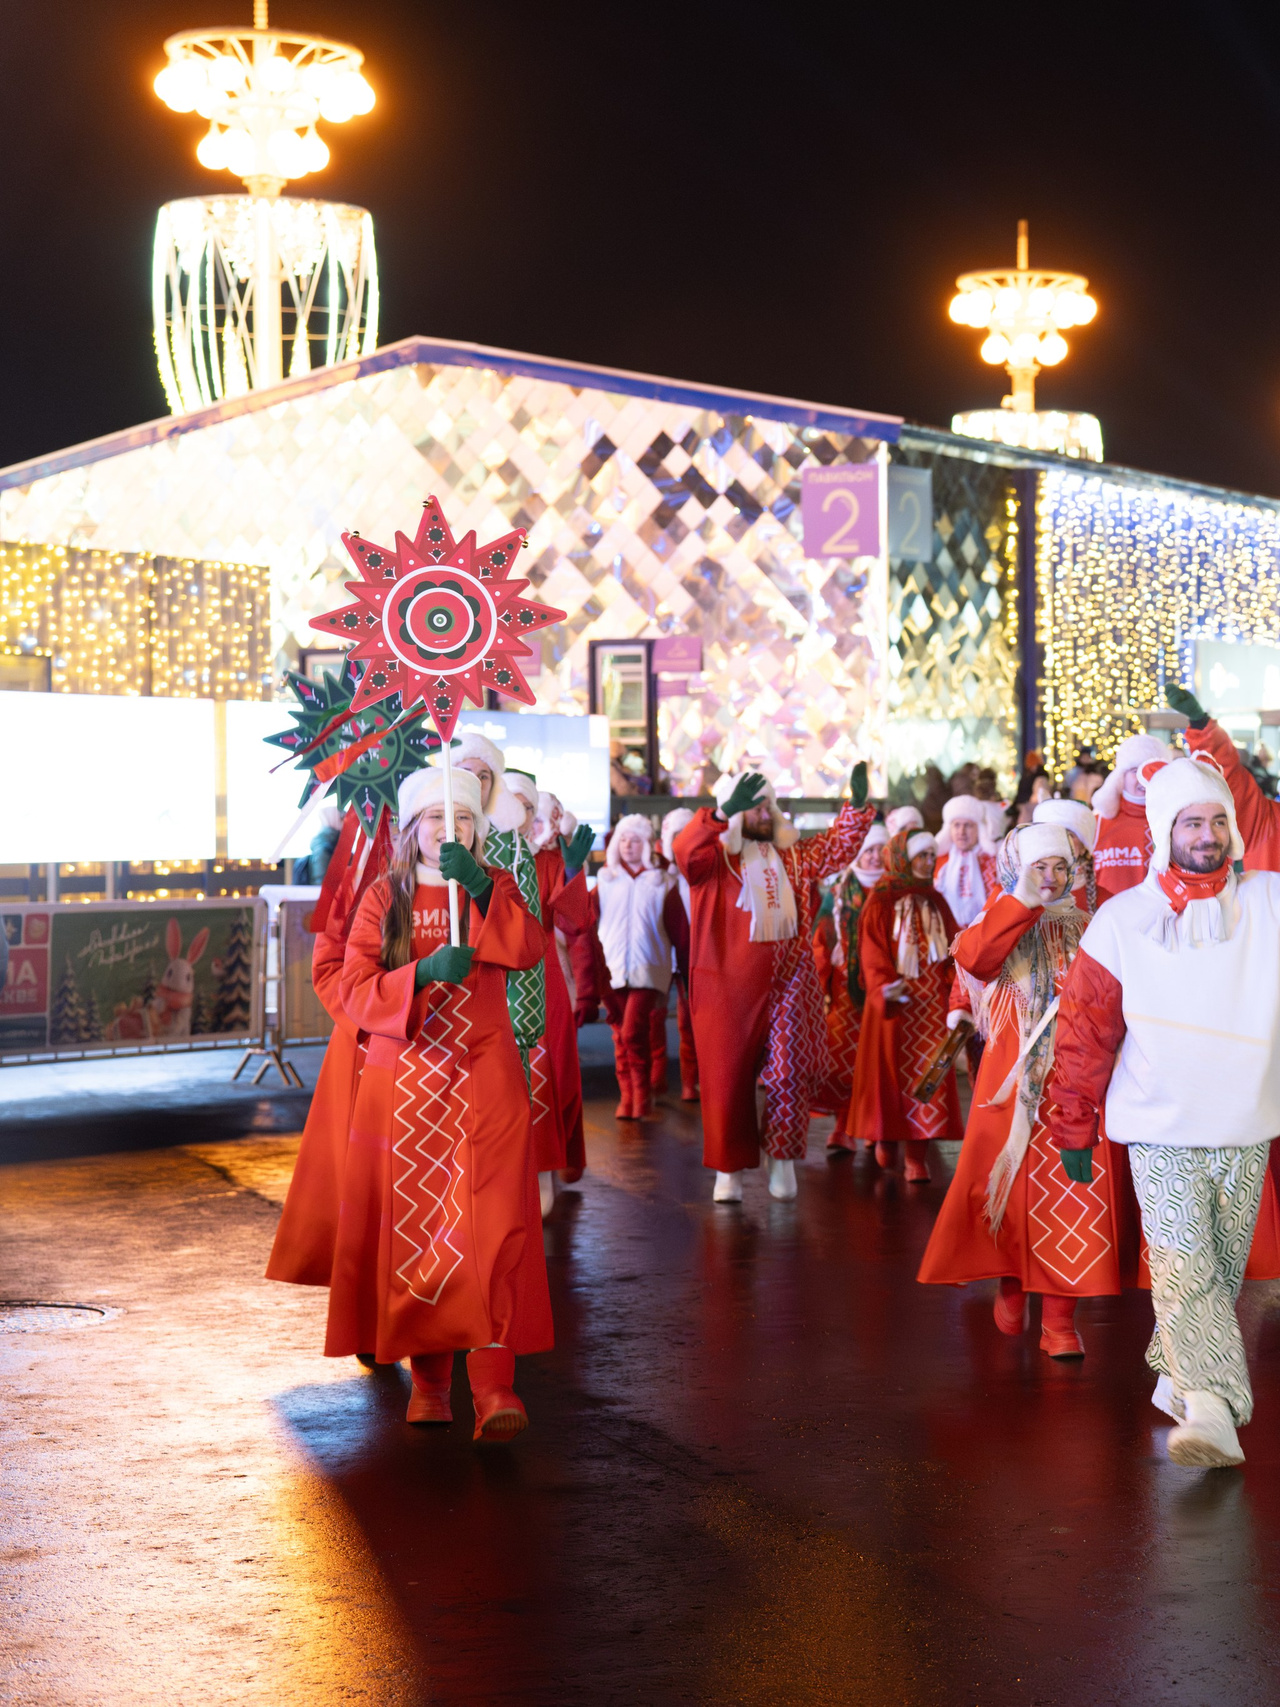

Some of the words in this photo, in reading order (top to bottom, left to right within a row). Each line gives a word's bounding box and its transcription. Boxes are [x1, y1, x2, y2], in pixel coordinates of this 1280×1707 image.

[821, 488, 860, 554] 2
[1094, 847, 1142, 863] ЗИМА
[421, 928, 449, 939] МОС
